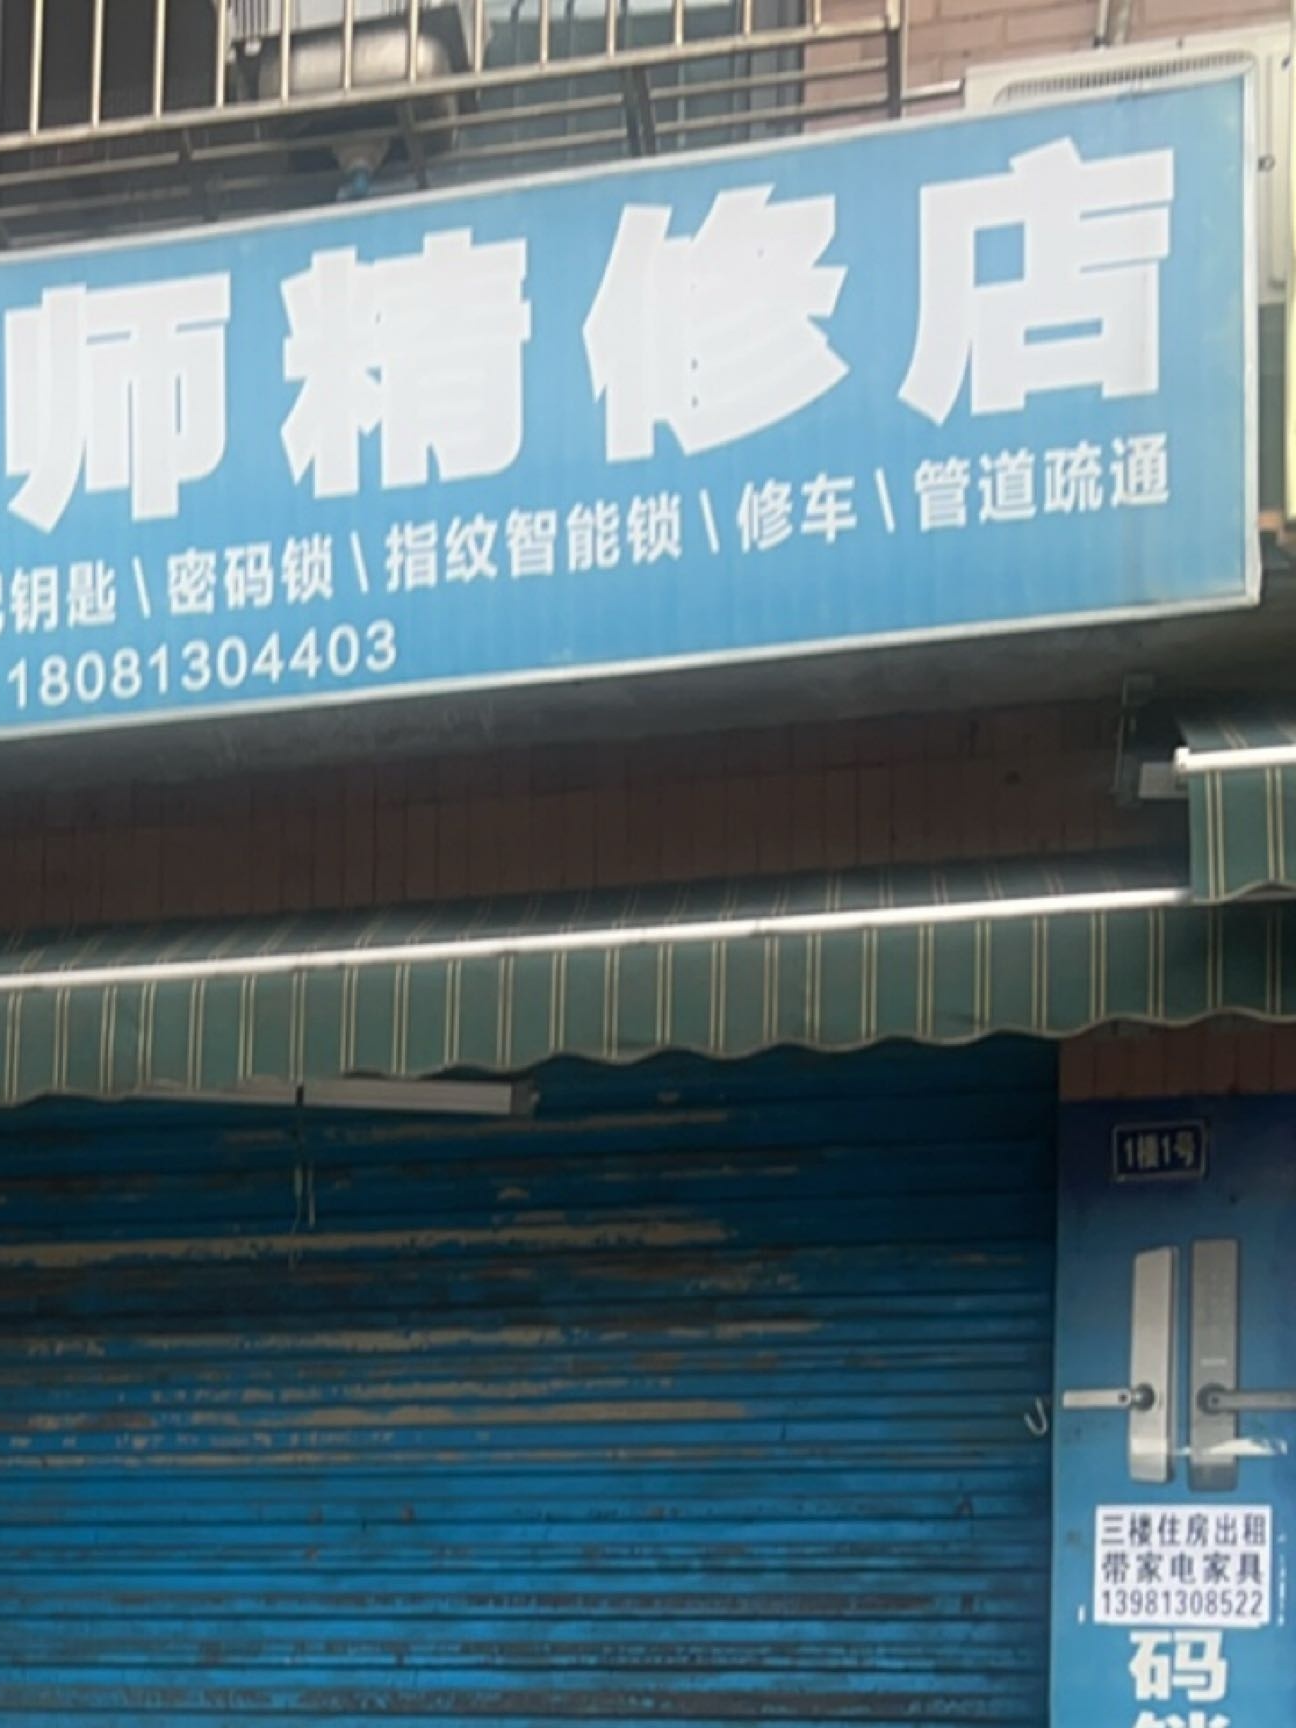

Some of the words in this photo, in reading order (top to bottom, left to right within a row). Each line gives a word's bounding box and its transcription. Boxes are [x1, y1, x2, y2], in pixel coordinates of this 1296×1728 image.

[8, 620, 398, 710] 18081304403
[1102, 1513, 1266, 1547] 三楼住房出租
[1102, 1551, 1263, 1585] 带家电家具
[1103, 1589, 1263, 1616] 13981308522
